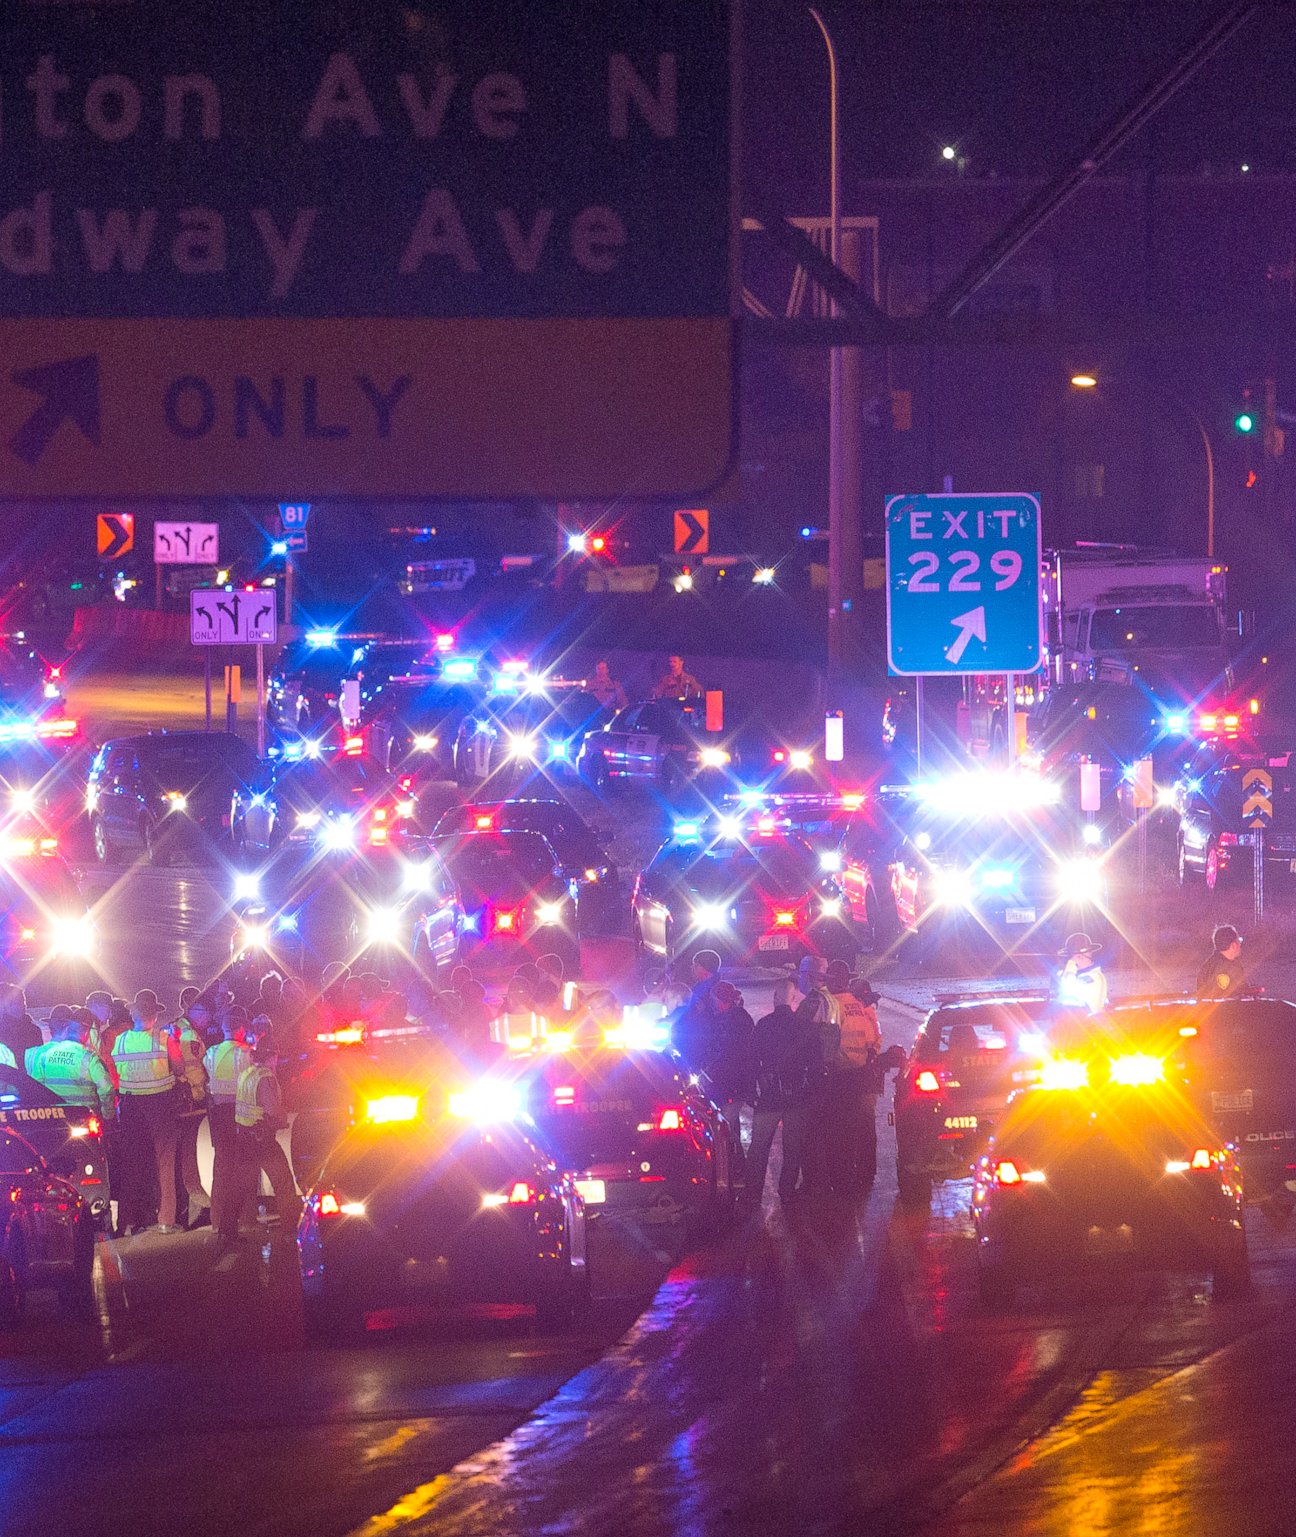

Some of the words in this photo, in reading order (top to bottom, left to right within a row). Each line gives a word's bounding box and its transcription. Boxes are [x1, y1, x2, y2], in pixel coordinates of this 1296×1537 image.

[305, 52, 529, 139] Ave
[607, 52, 678, 139] N
[400, 188, 631, 274] Ave
[162, 374, 415, 440] ONLY
[285, 506, 303, 522] 81
[909, 510, 1017, 539] EXIT
[907, 550, 1023, 592] 229
[195, 631, 218, 640] ONLY
[49, 1057, 76, 1065] PATROL
[53, 1050, 75, 1058] STATE
[14, 1107, 66, 1121] TROOPER
[944, 1116, 977, 1129] 44112
